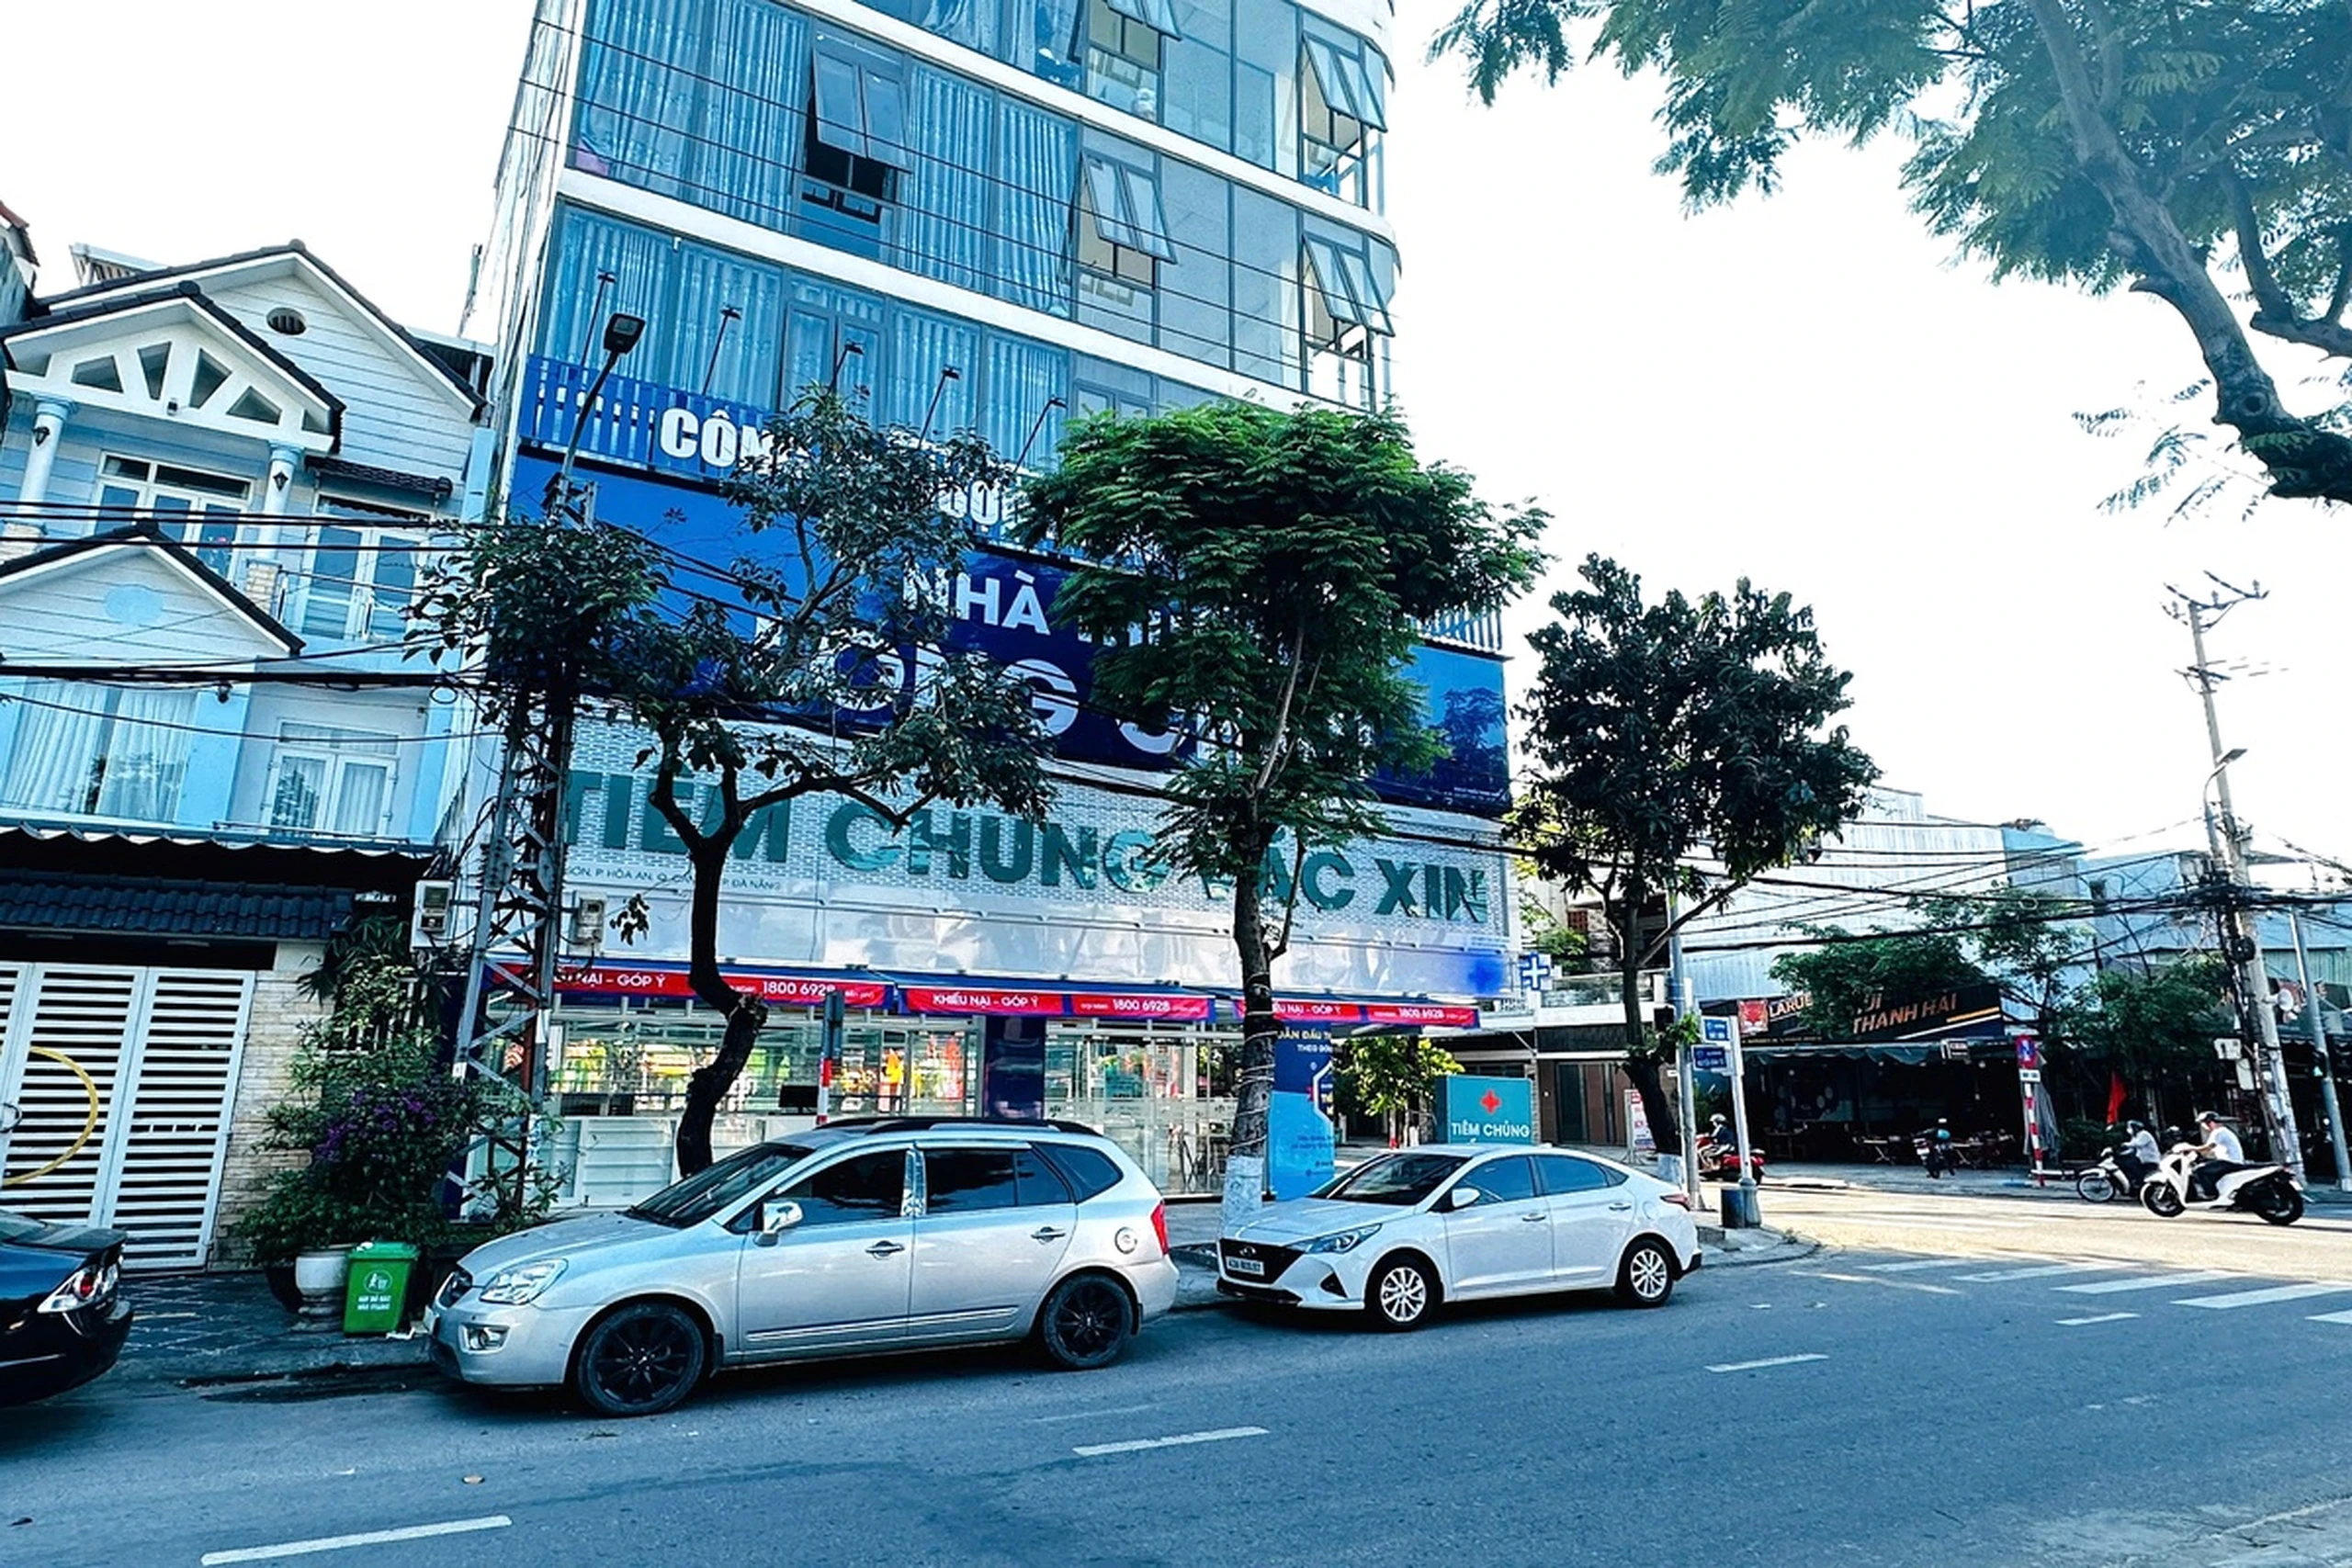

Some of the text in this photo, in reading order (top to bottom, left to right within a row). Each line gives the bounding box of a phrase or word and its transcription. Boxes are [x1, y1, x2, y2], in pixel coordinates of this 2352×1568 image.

[1374, 857, 1488, 922] XIN
[616, 972, 651, 987] GÓP
[763, 980, 797, 994] 1800
[1113, 998, 1140, 1011] 1800
[1142, 999, 1170, 1012] 6928
[1769, 991, 1813, 1018] LARUE
[1852, 1003, 1918, 1034] THANH
[1452, 1119, 1480, 1135] TIÊM
